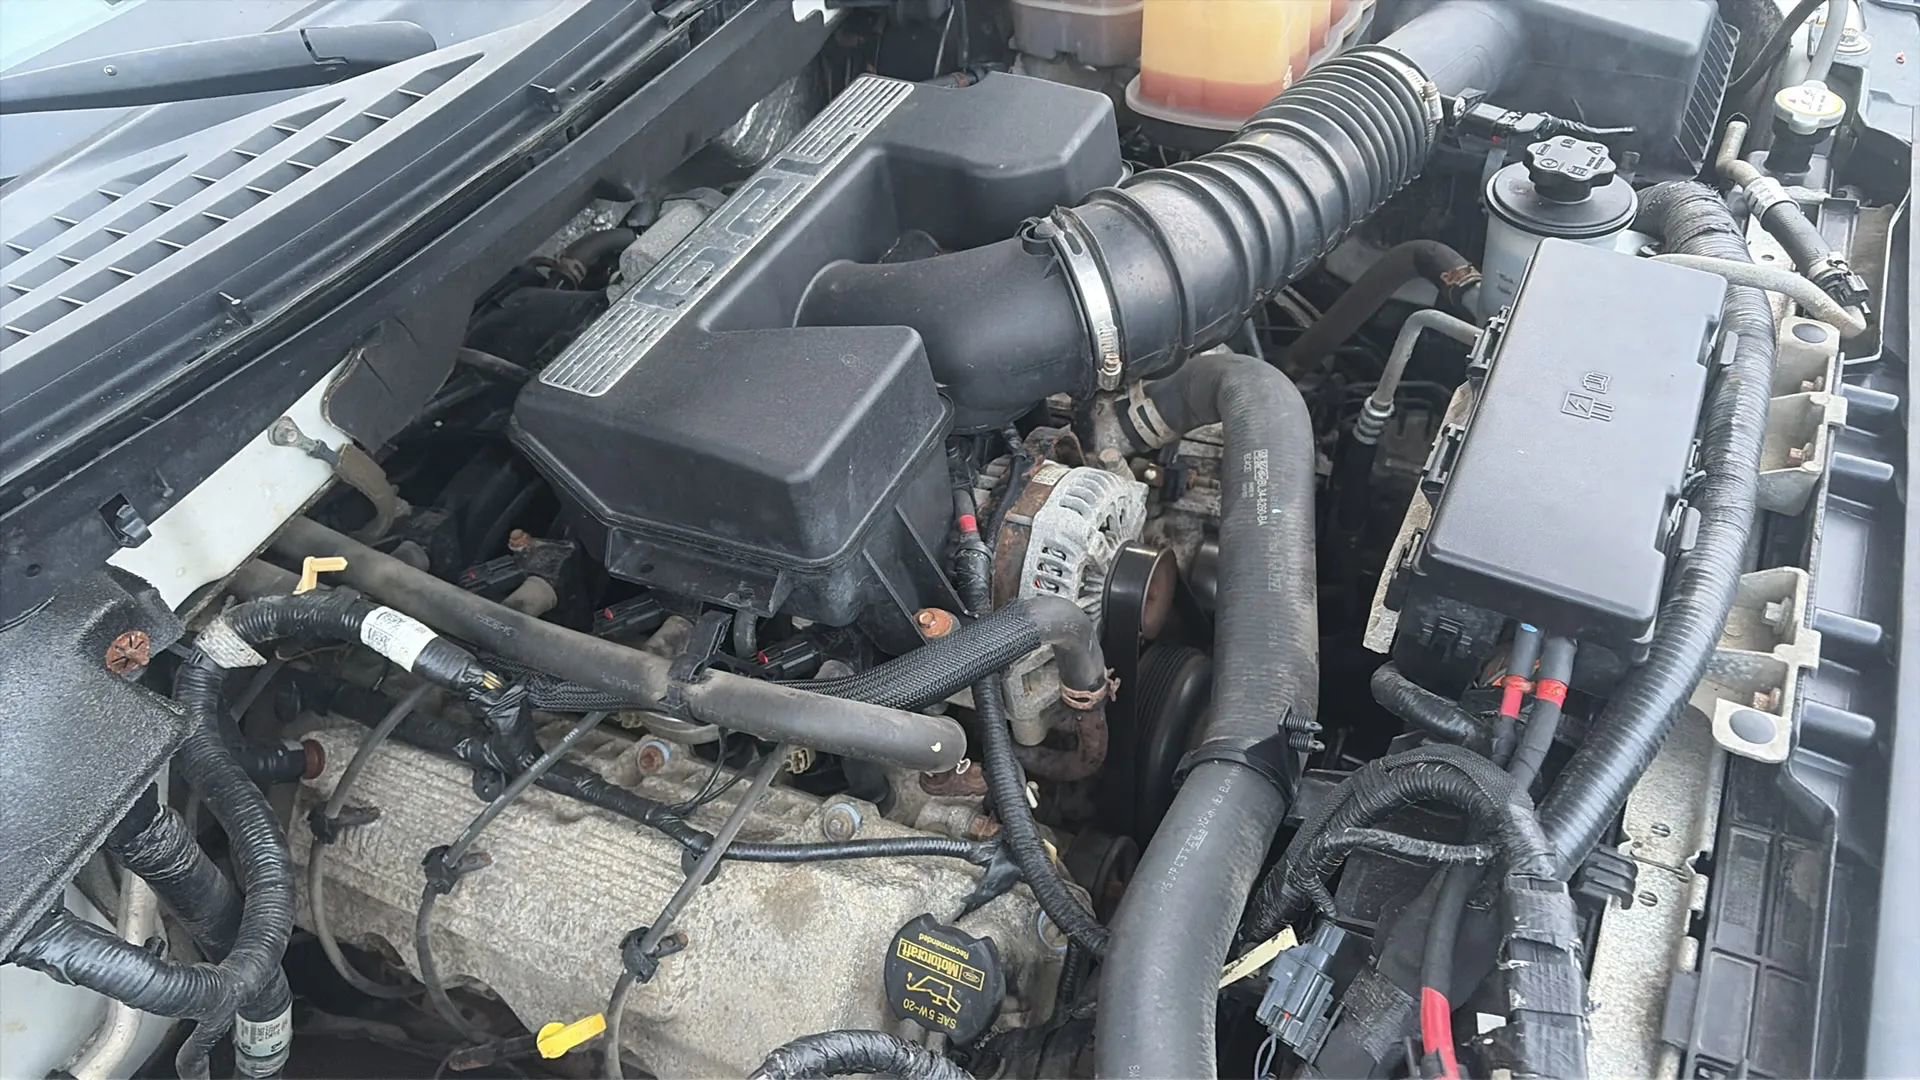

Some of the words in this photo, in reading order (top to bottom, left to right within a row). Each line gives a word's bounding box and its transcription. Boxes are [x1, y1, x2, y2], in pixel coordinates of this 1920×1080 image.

[918, 933, 970, 960] Recommended
[901, 942, 960, 978] Motorcraft
[903, 998, 936, 1020] 5W-20
[936, 1012, 957, 1030] SAE
